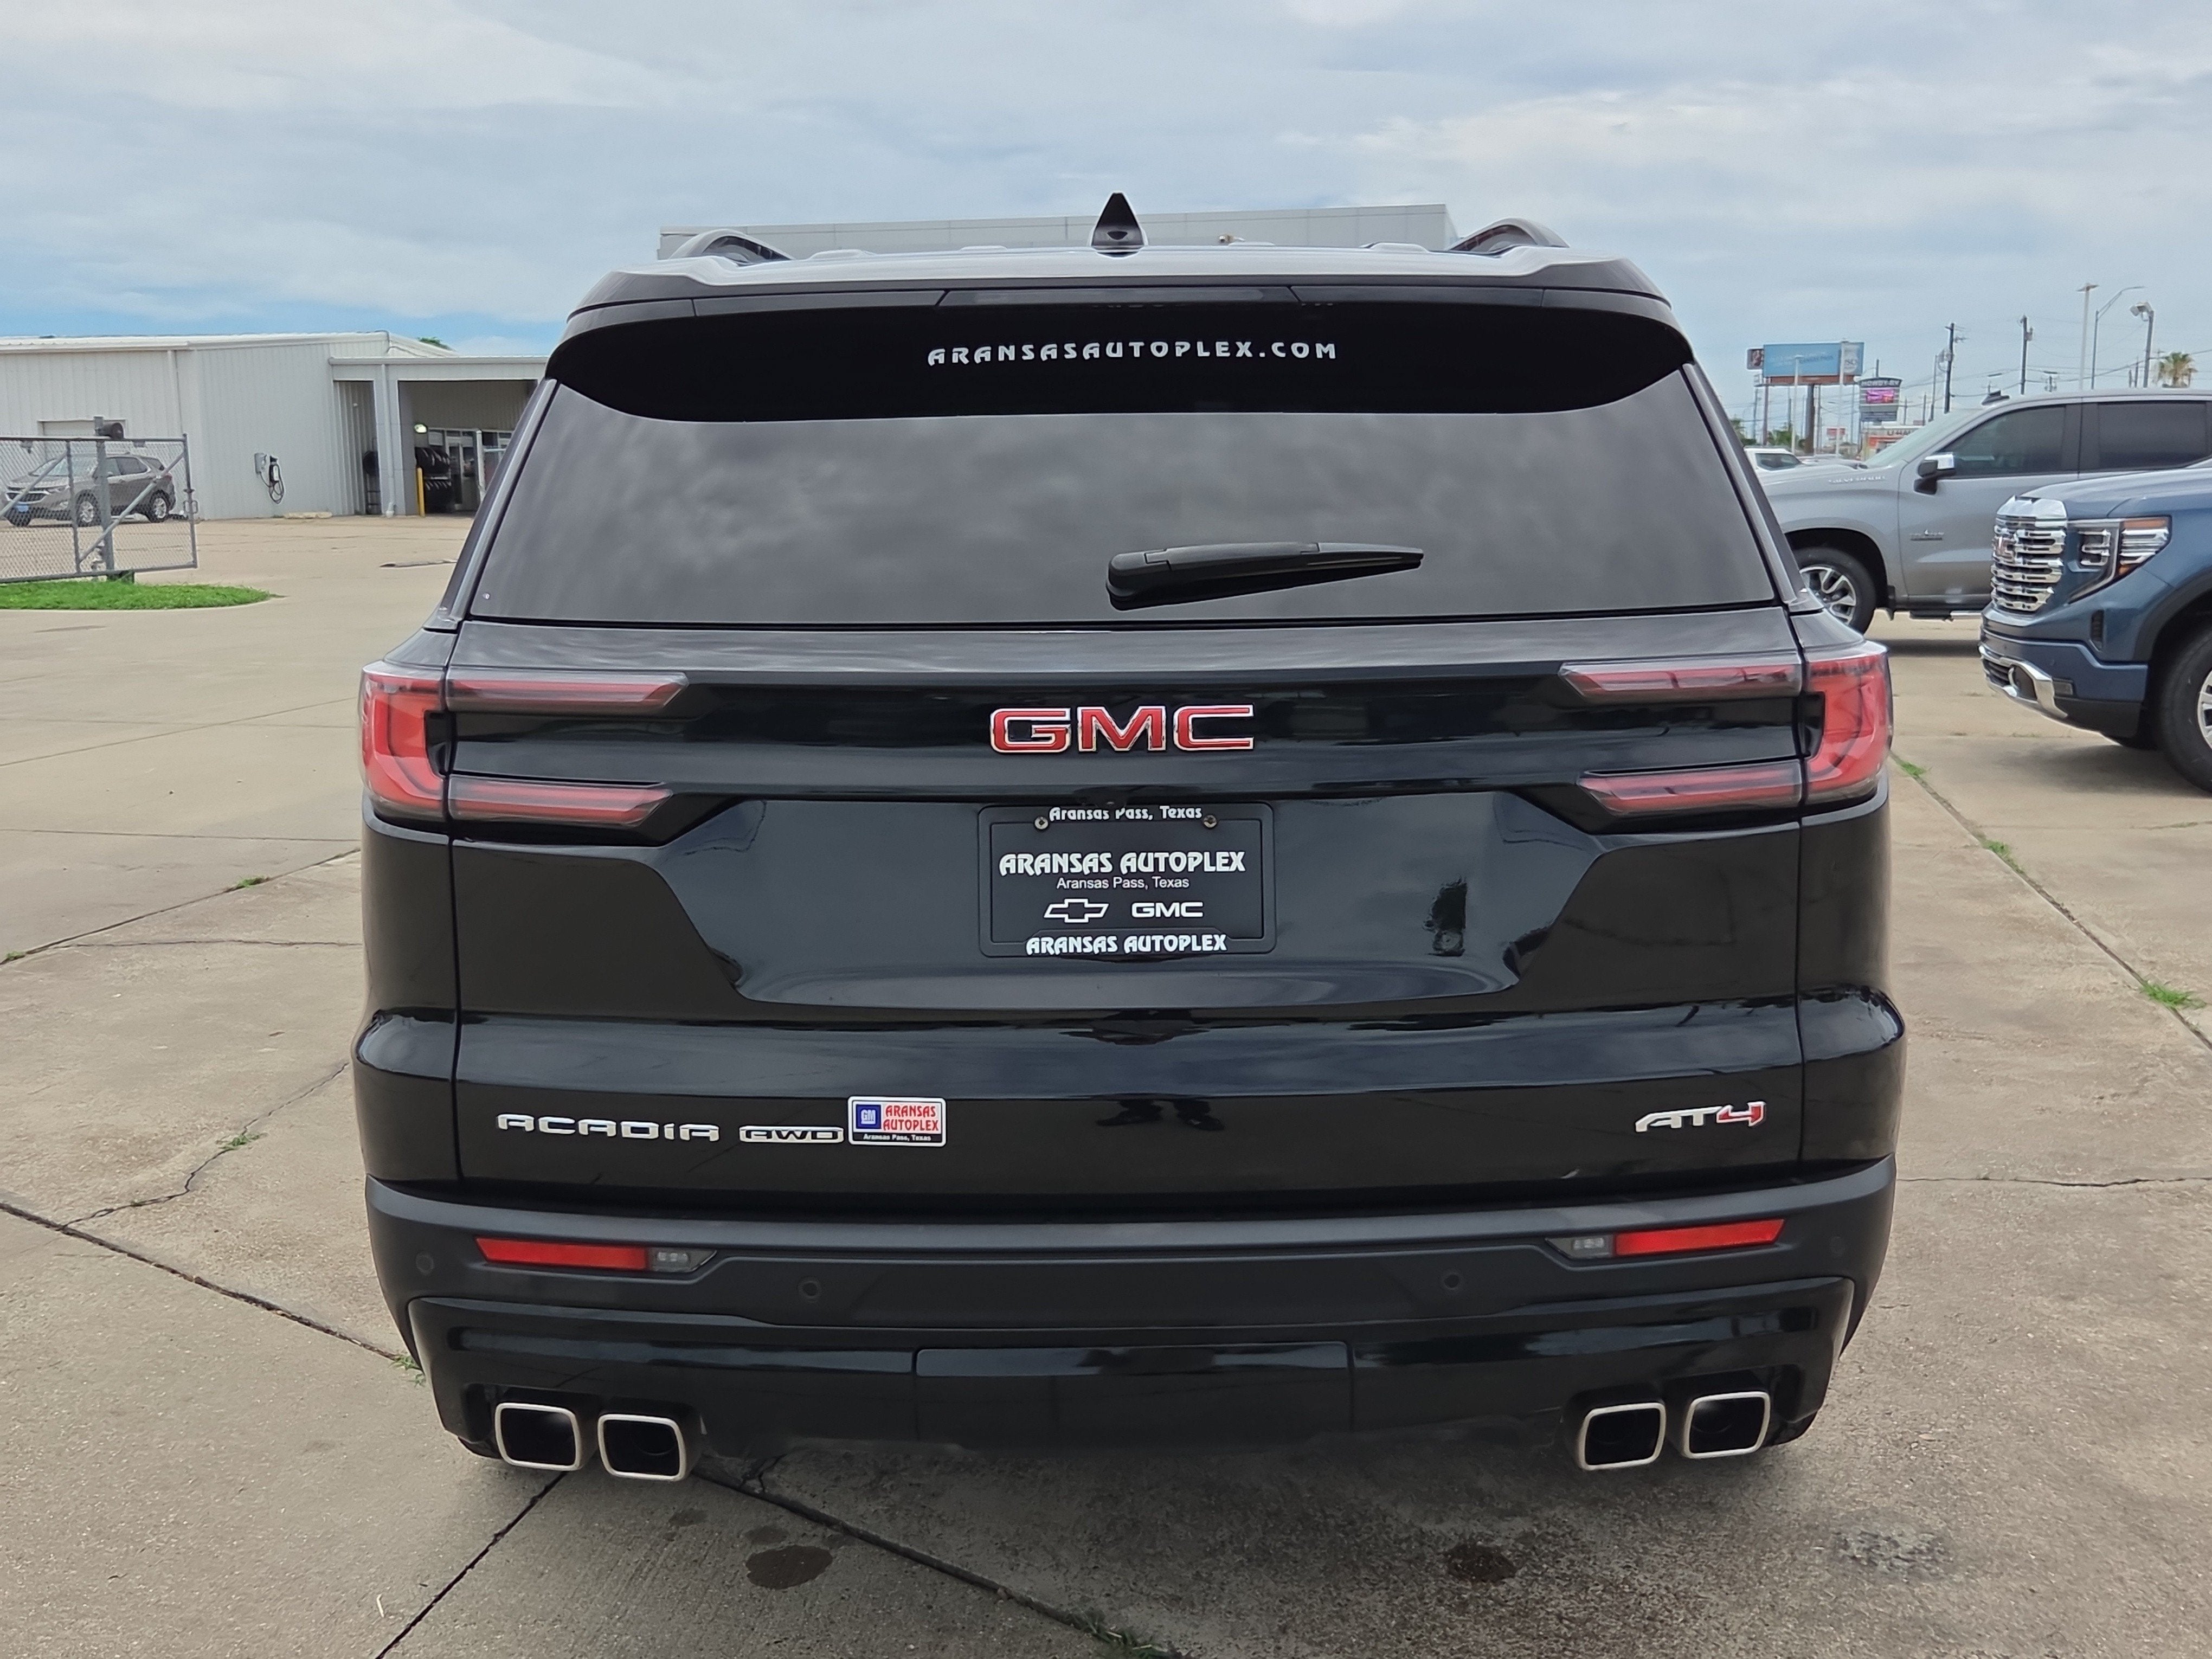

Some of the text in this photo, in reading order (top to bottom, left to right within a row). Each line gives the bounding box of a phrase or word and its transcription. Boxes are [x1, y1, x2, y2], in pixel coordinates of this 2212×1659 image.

[928, 341, 1336, 366] ARANSASAUTOPLEX.COM
[990, 704, 1253, 753] GMC
[1049, 807, 1109, 821] Aransas
[1159, 805, 1202, 819] Texas
[999, 851, 1246, 876] ARANSAS AUTOPLEX
[1056, 876, 1189, 890] Aransas Pass, Texas
[1131, 902, 1203, 918] GMC
[1026, 934, 1227, 955] ARANSAS AUTOPLEX
[885, 1105, 936, 1118] ARANSAS
[1635, 1101, 1766, 1133] AT4
[497, 1114, 840, 1142] ACADIA AWD
[883, 1119, 939, 1131] AUTOPLEX
